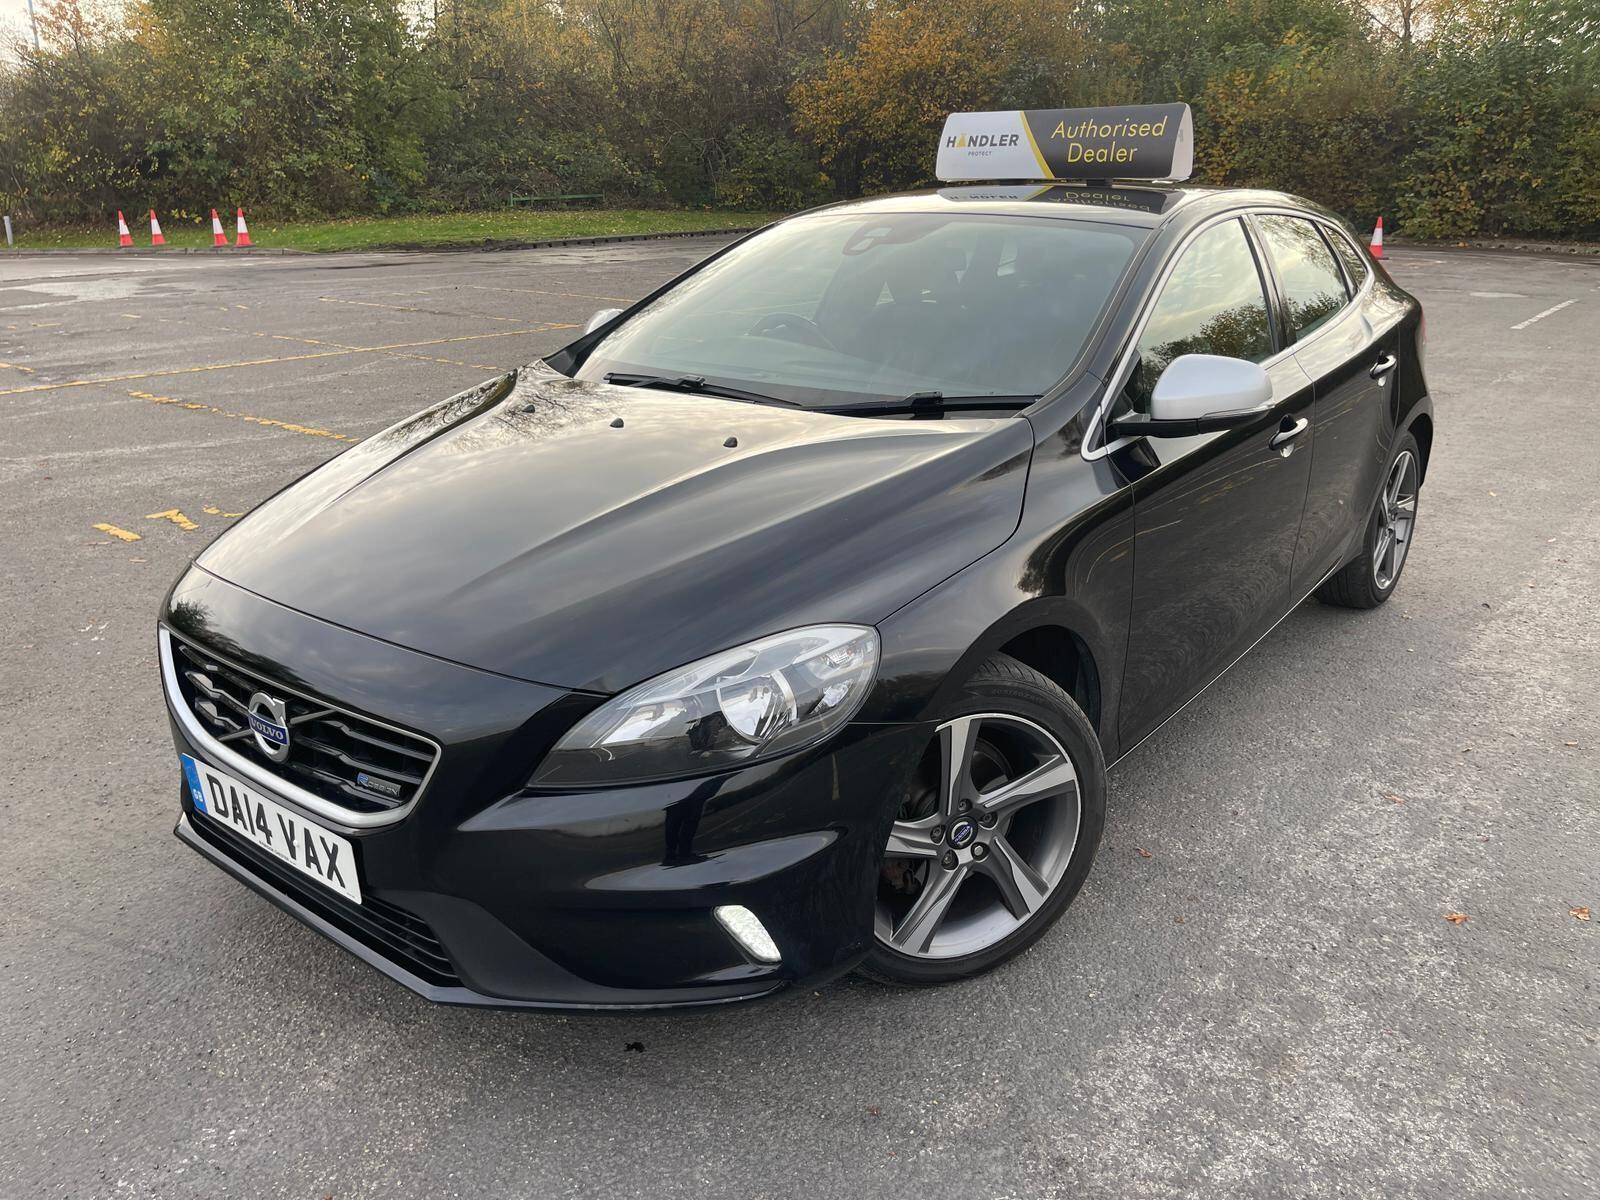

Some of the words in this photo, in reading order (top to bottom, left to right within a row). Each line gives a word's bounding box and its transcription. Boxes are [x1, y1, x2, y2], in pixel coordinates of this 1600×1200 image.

[1051, 115, 1168, 138] Authorised
[1067, 141, 1138, 162] Dealer
[250, 715, 284, 740] VOLVO
[206, 773, 273, 845] DA14
[276, 812, 346, 888] VAX
